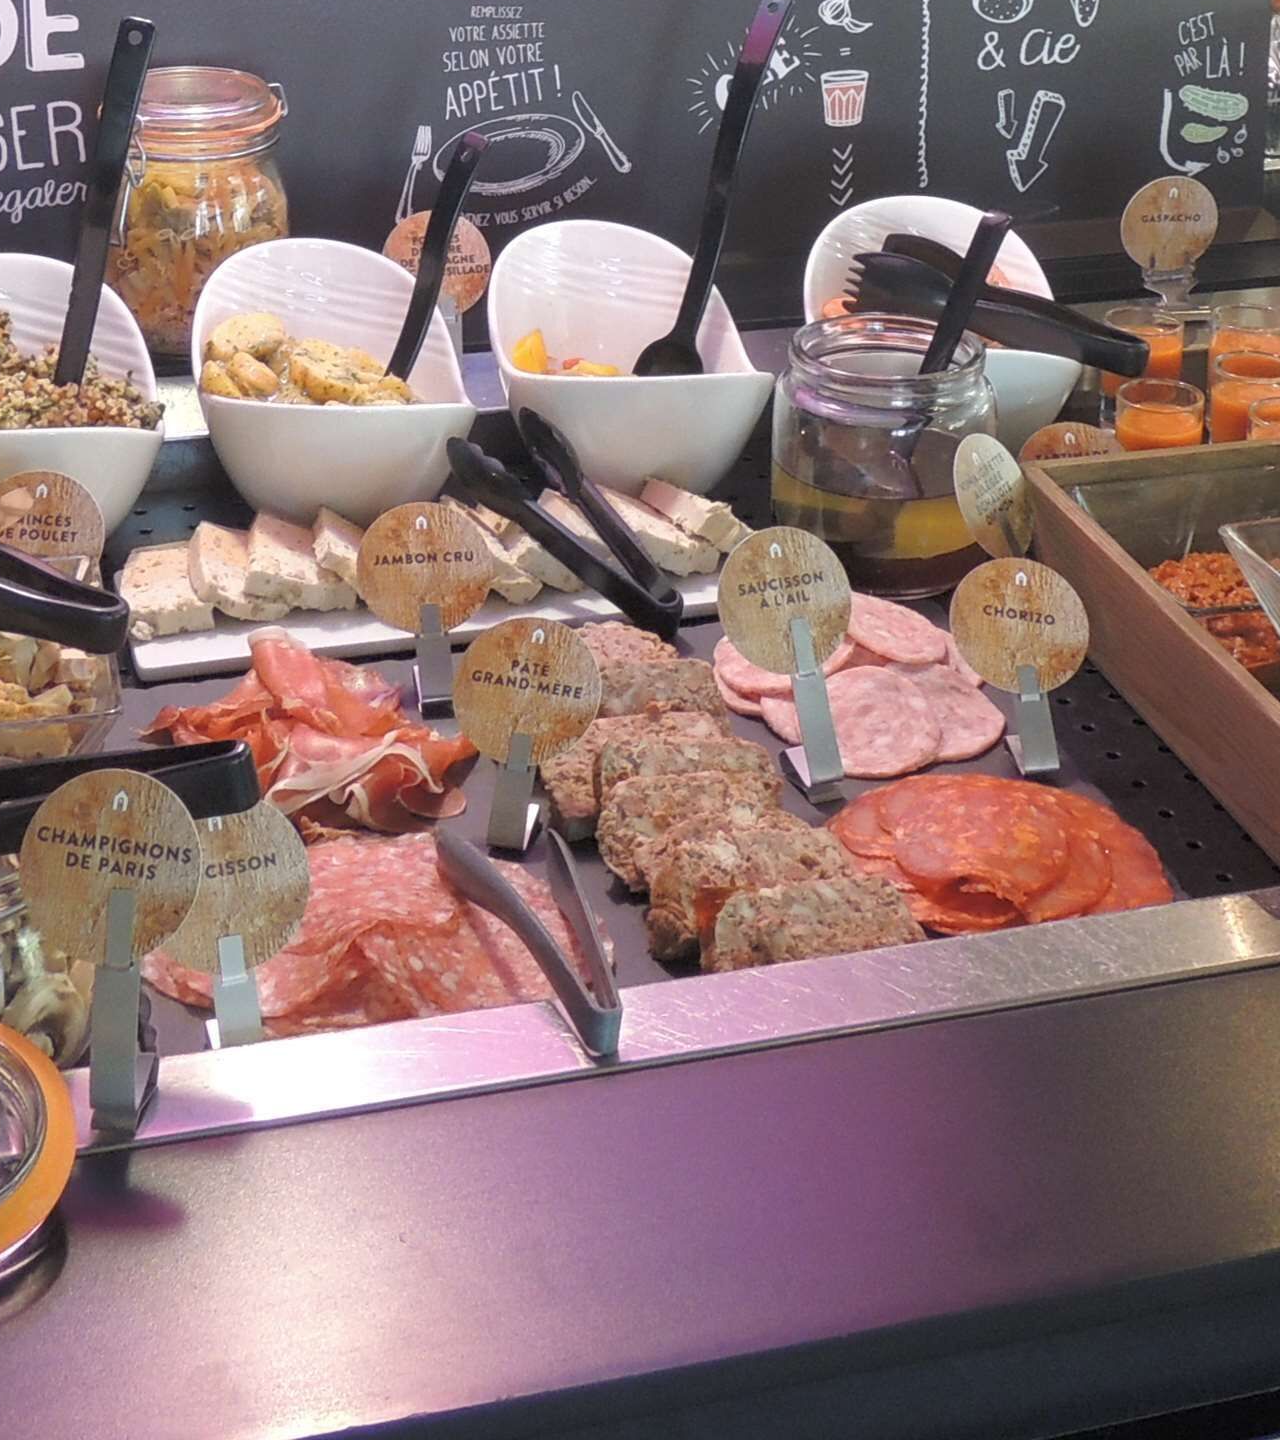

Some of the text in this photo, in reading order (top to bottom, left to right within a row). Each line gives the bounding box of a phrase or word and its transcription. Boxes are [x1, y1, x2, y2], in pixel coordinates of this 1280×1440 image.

[470, 5, 523, 19] REMPLISSEZ
[448, 22, 545, 42] VOTRE ASSIETTE
[1178, 10, 1215, 45] C'EST
[442, 42, 545, 73] SELON VOTRE
[977, 31, 1006, 71] &
[1174, 46, 1203, 77] PAR
[1205, 36, 1231, 79] LÀ
[445, 67, 545, 121] APPÉTIT
[494, 211, 519, 225] VOUS
[521, 200, 552, 221] SERVIR
[1141, 213, 1202, 223] GASPACHO
[19, 528, 79, 543] POULET
[373, 550, 474, 566] JAMBON CRU
[737, 570, 825, 597] SAUCISSON
[774, 589, 811, 607] L'AIL
[982, 603, 1057, 626] CHORIZO
[471, 670, 583, 700] GRAND-MÈRE
[37, 825, 193, 864] CHAMPIGNONS
[65, 851, 157, 880] DE PARIS
